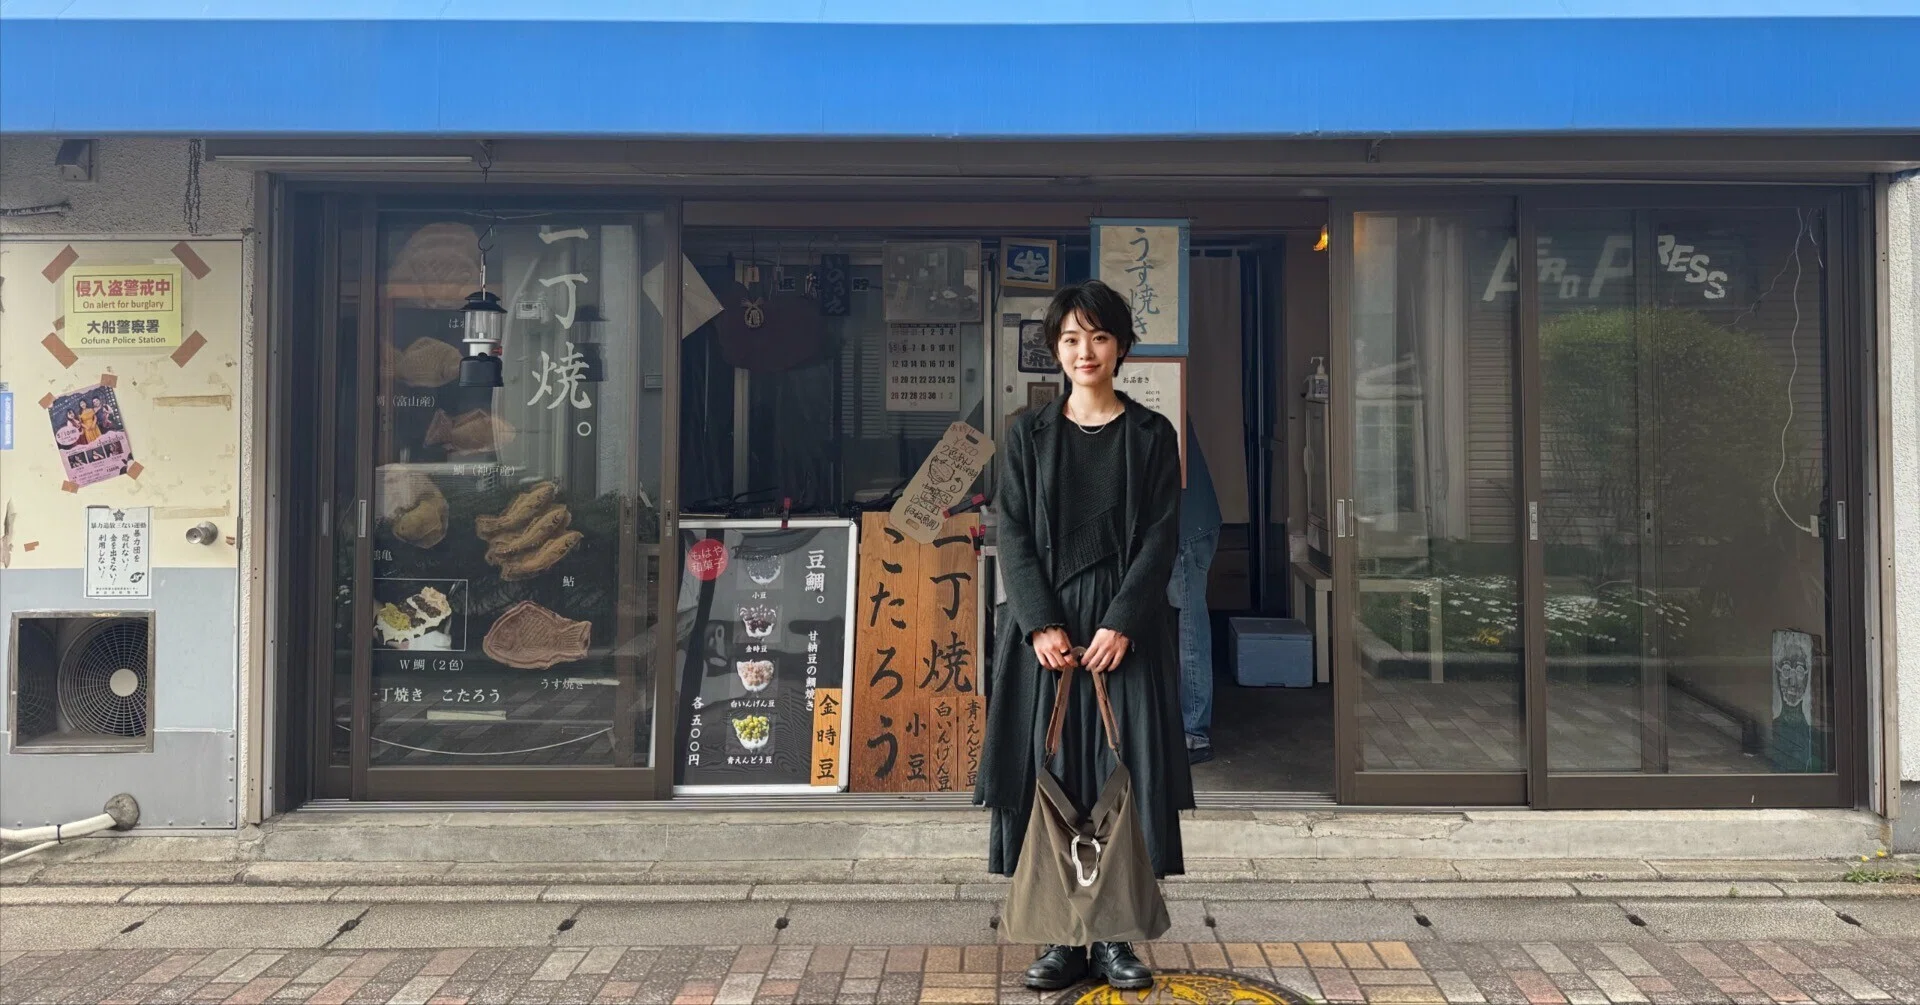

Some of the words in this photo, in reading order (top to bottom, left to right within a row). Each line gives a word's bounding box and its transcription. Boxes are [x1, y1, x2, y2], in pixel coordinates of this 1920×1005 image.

[76, 279, 170, 297] 侵入盗警戒中
[83, 301, 94, 309] On
[96, 300, 115, 309] alert
[117, 300, 130, 309] for
[131, 300, 164, 310] burglary
[87, 319, 159, 334] 大船警察署
[81, 337, 110, 345] Oofuna
[112, 336, 136, 344] Police
[138, 336, 166, 344] Station
[133, 529, 141, 562] 暴力団を
[690, 545, 722, 560] もはや
[562, 575, 575, 587] 鮎
[805, 550, 826, 604] 豆鯛。
[752, 591, 767, 599] 小豆
[919, 535, 973, 693] 一丁焼
[745, 644, 767, 653] 金時豆
[866, 527, 907, 780] こたろう
[804, 630, 819, 711] 甘納豆の鯛焼き
[540, 678, 584, 690] うす焼き
[373, 687, 423, 703] 丁焼き
[442, 688, 500, 704] こたろう
[730, 700, 775, 708] 白いんげん豆
[688, 696, 705, 766] 各五〇〇円
[816, 694, 839, 779] 金時豆
[906, 712, 928, 782] 小豆
[935, 701, 952, 791] 白いんげん豆
[964, 699, 982, 787] 青えんどう豆
[727, 756, 772, 765] 青えんどう豆
